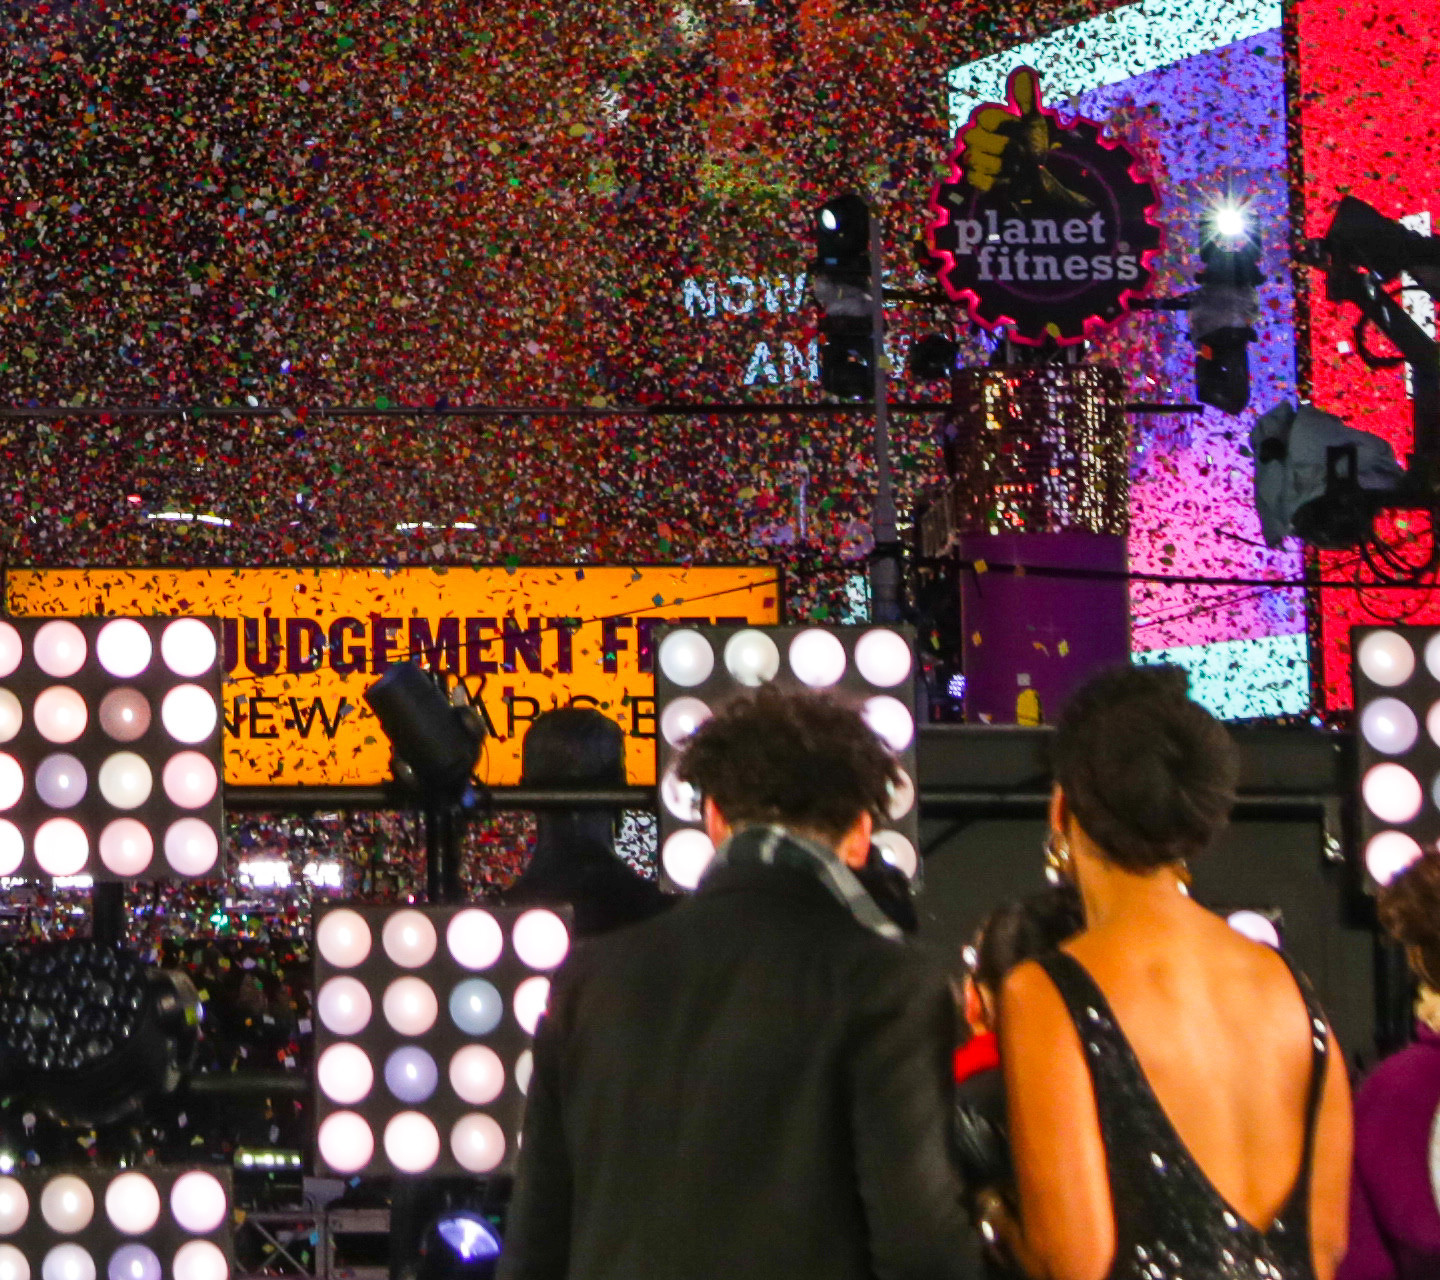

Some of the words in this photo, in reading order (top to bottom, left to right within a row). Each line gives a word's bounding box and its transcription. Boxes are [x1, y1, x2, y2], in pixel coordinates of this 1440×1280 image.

[953, 209, 1107, 261] planet
[977, 248, 1139, 283] fitness
[683, 272, 808, 318] NOW
[221, 617, 583, 675] JUDGEMENT
